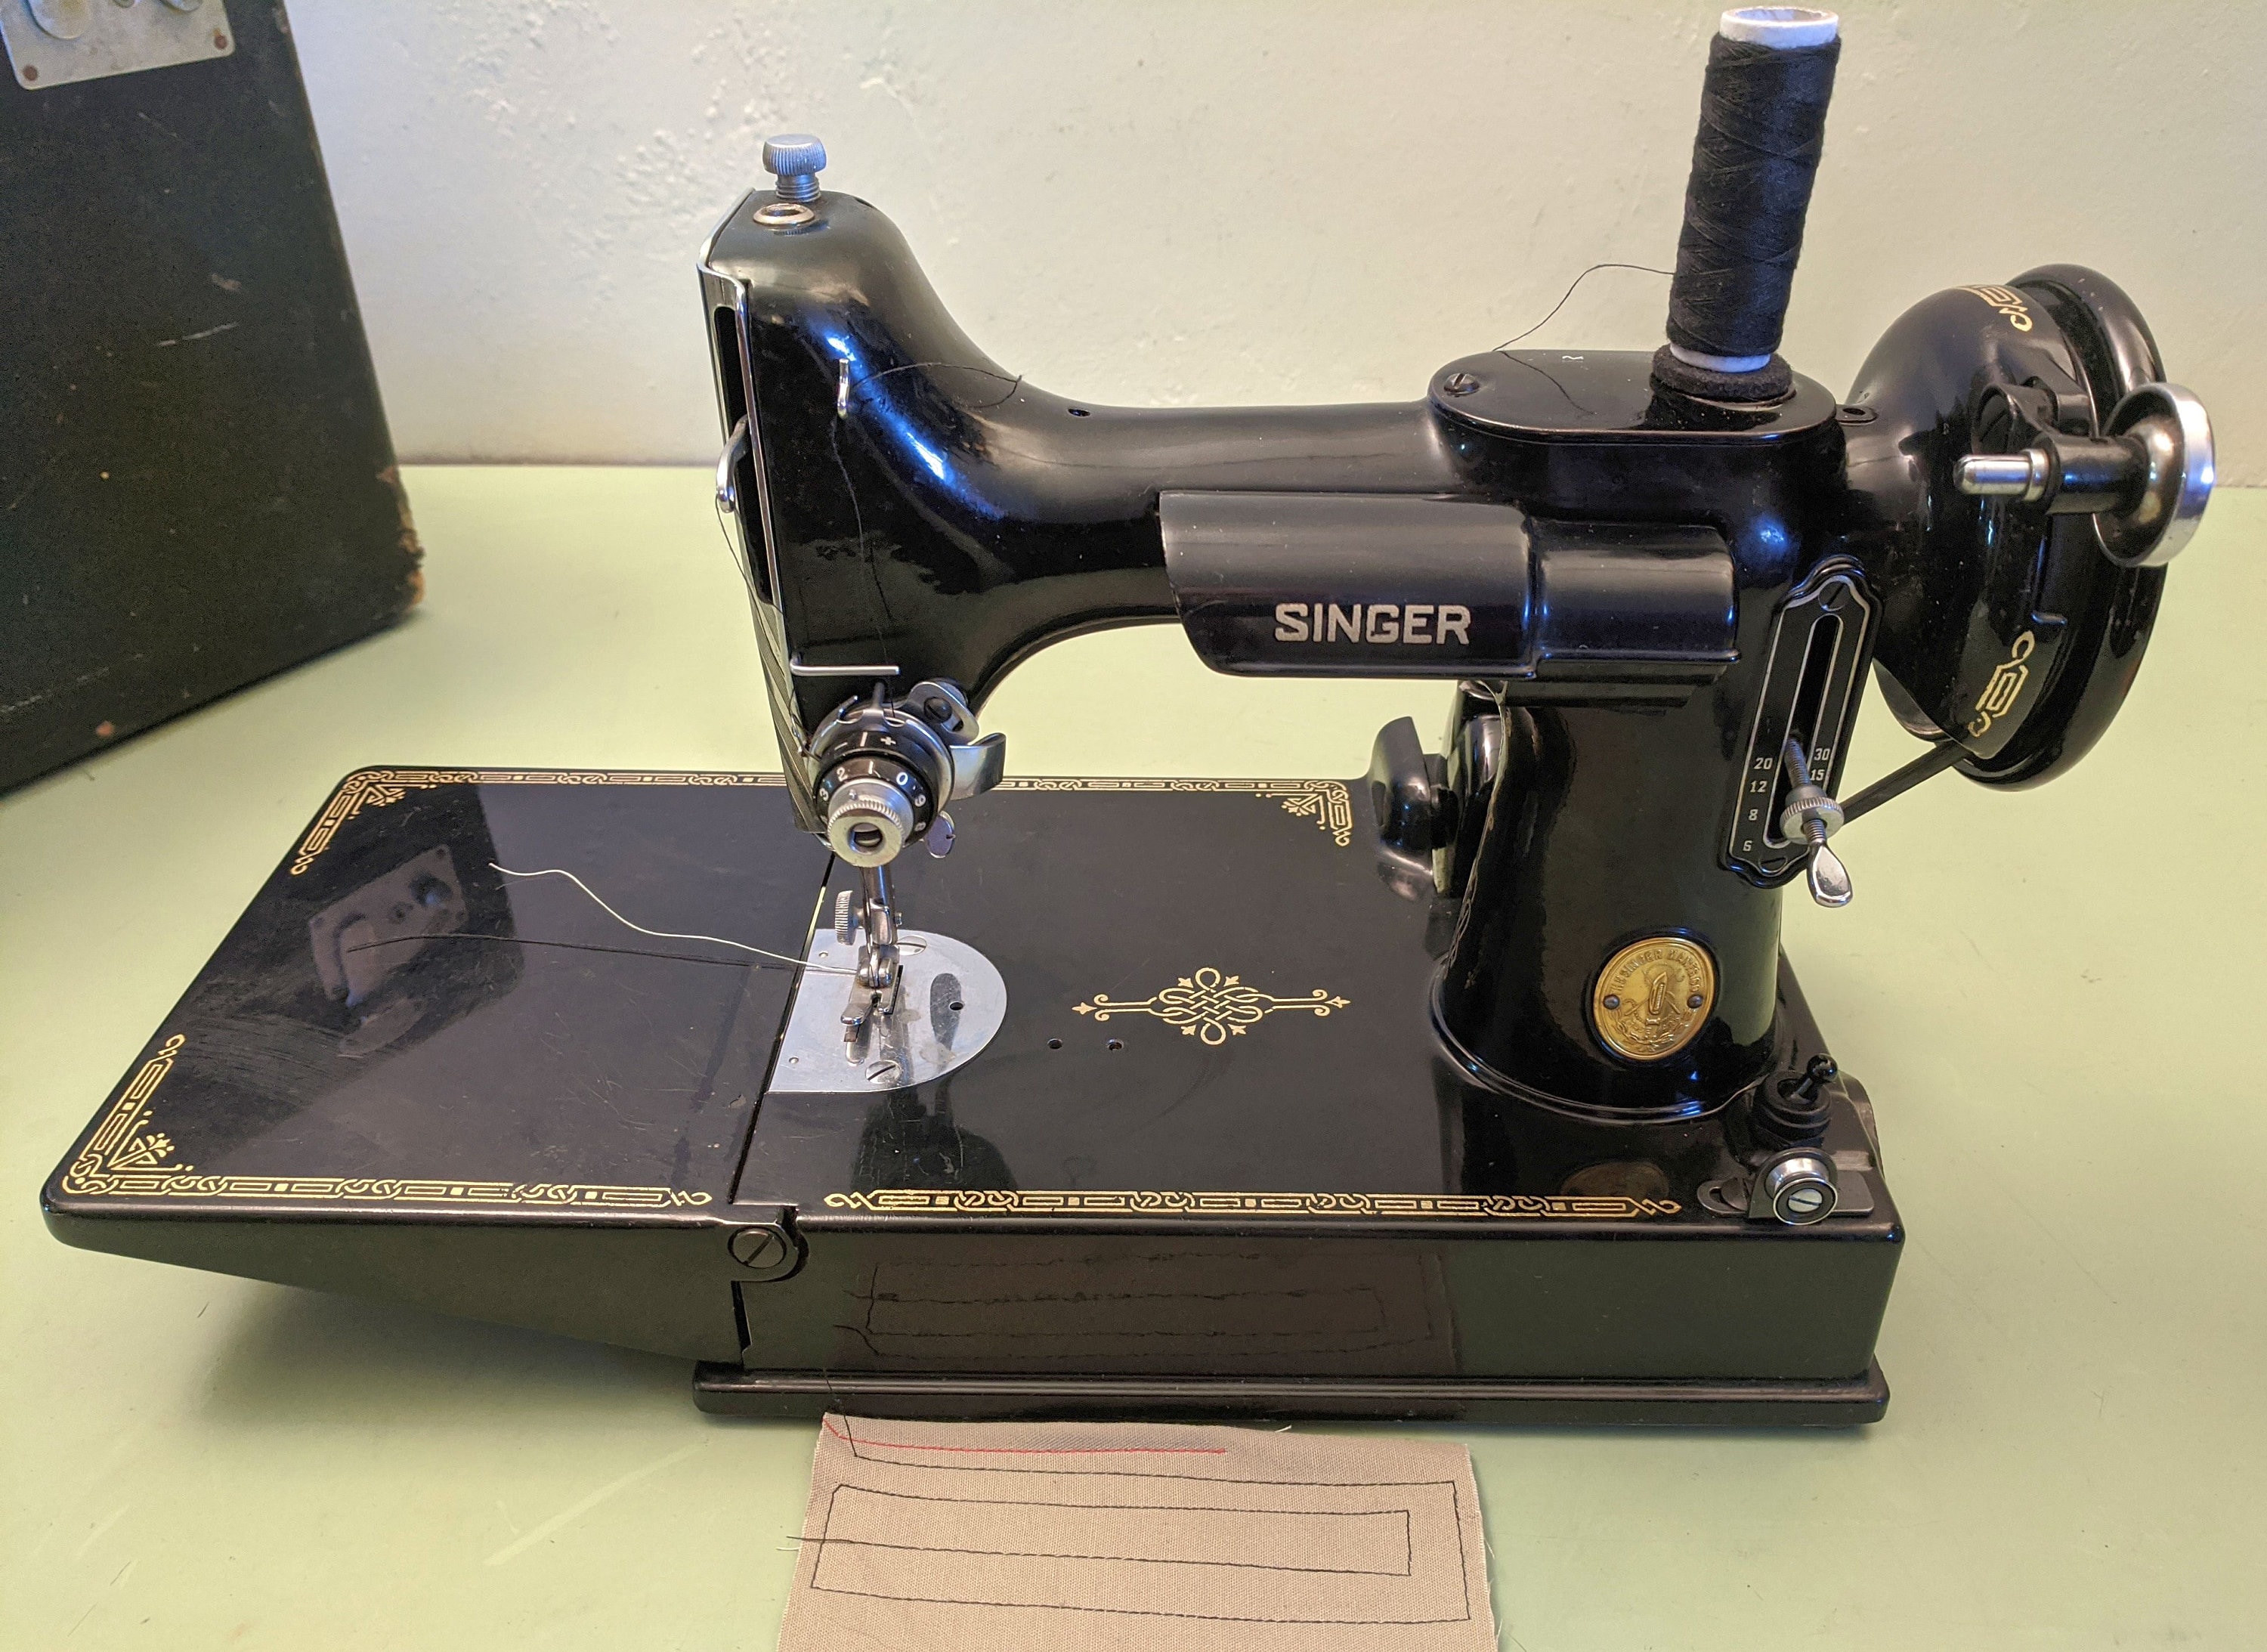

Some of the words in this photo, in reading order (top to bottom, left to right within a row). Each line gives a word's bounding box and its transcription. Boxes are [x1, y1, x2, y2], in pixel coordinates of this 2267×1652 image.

[1275, 603, 1471, 645] SINGER
[1814, 748, 1830, 761] 30
[1754, 757, 1772, 770] 20
[1811, 769, 1825, 781] 15
[819, 787, 830, 801] 3
[837, 767, 848, 782] 2
[896, 772, 908, 785] 0
[914, 794, 926, 806] 9
[1750, 781, 1768, 793] 12
[1749, 809, 1758, 821] 8
